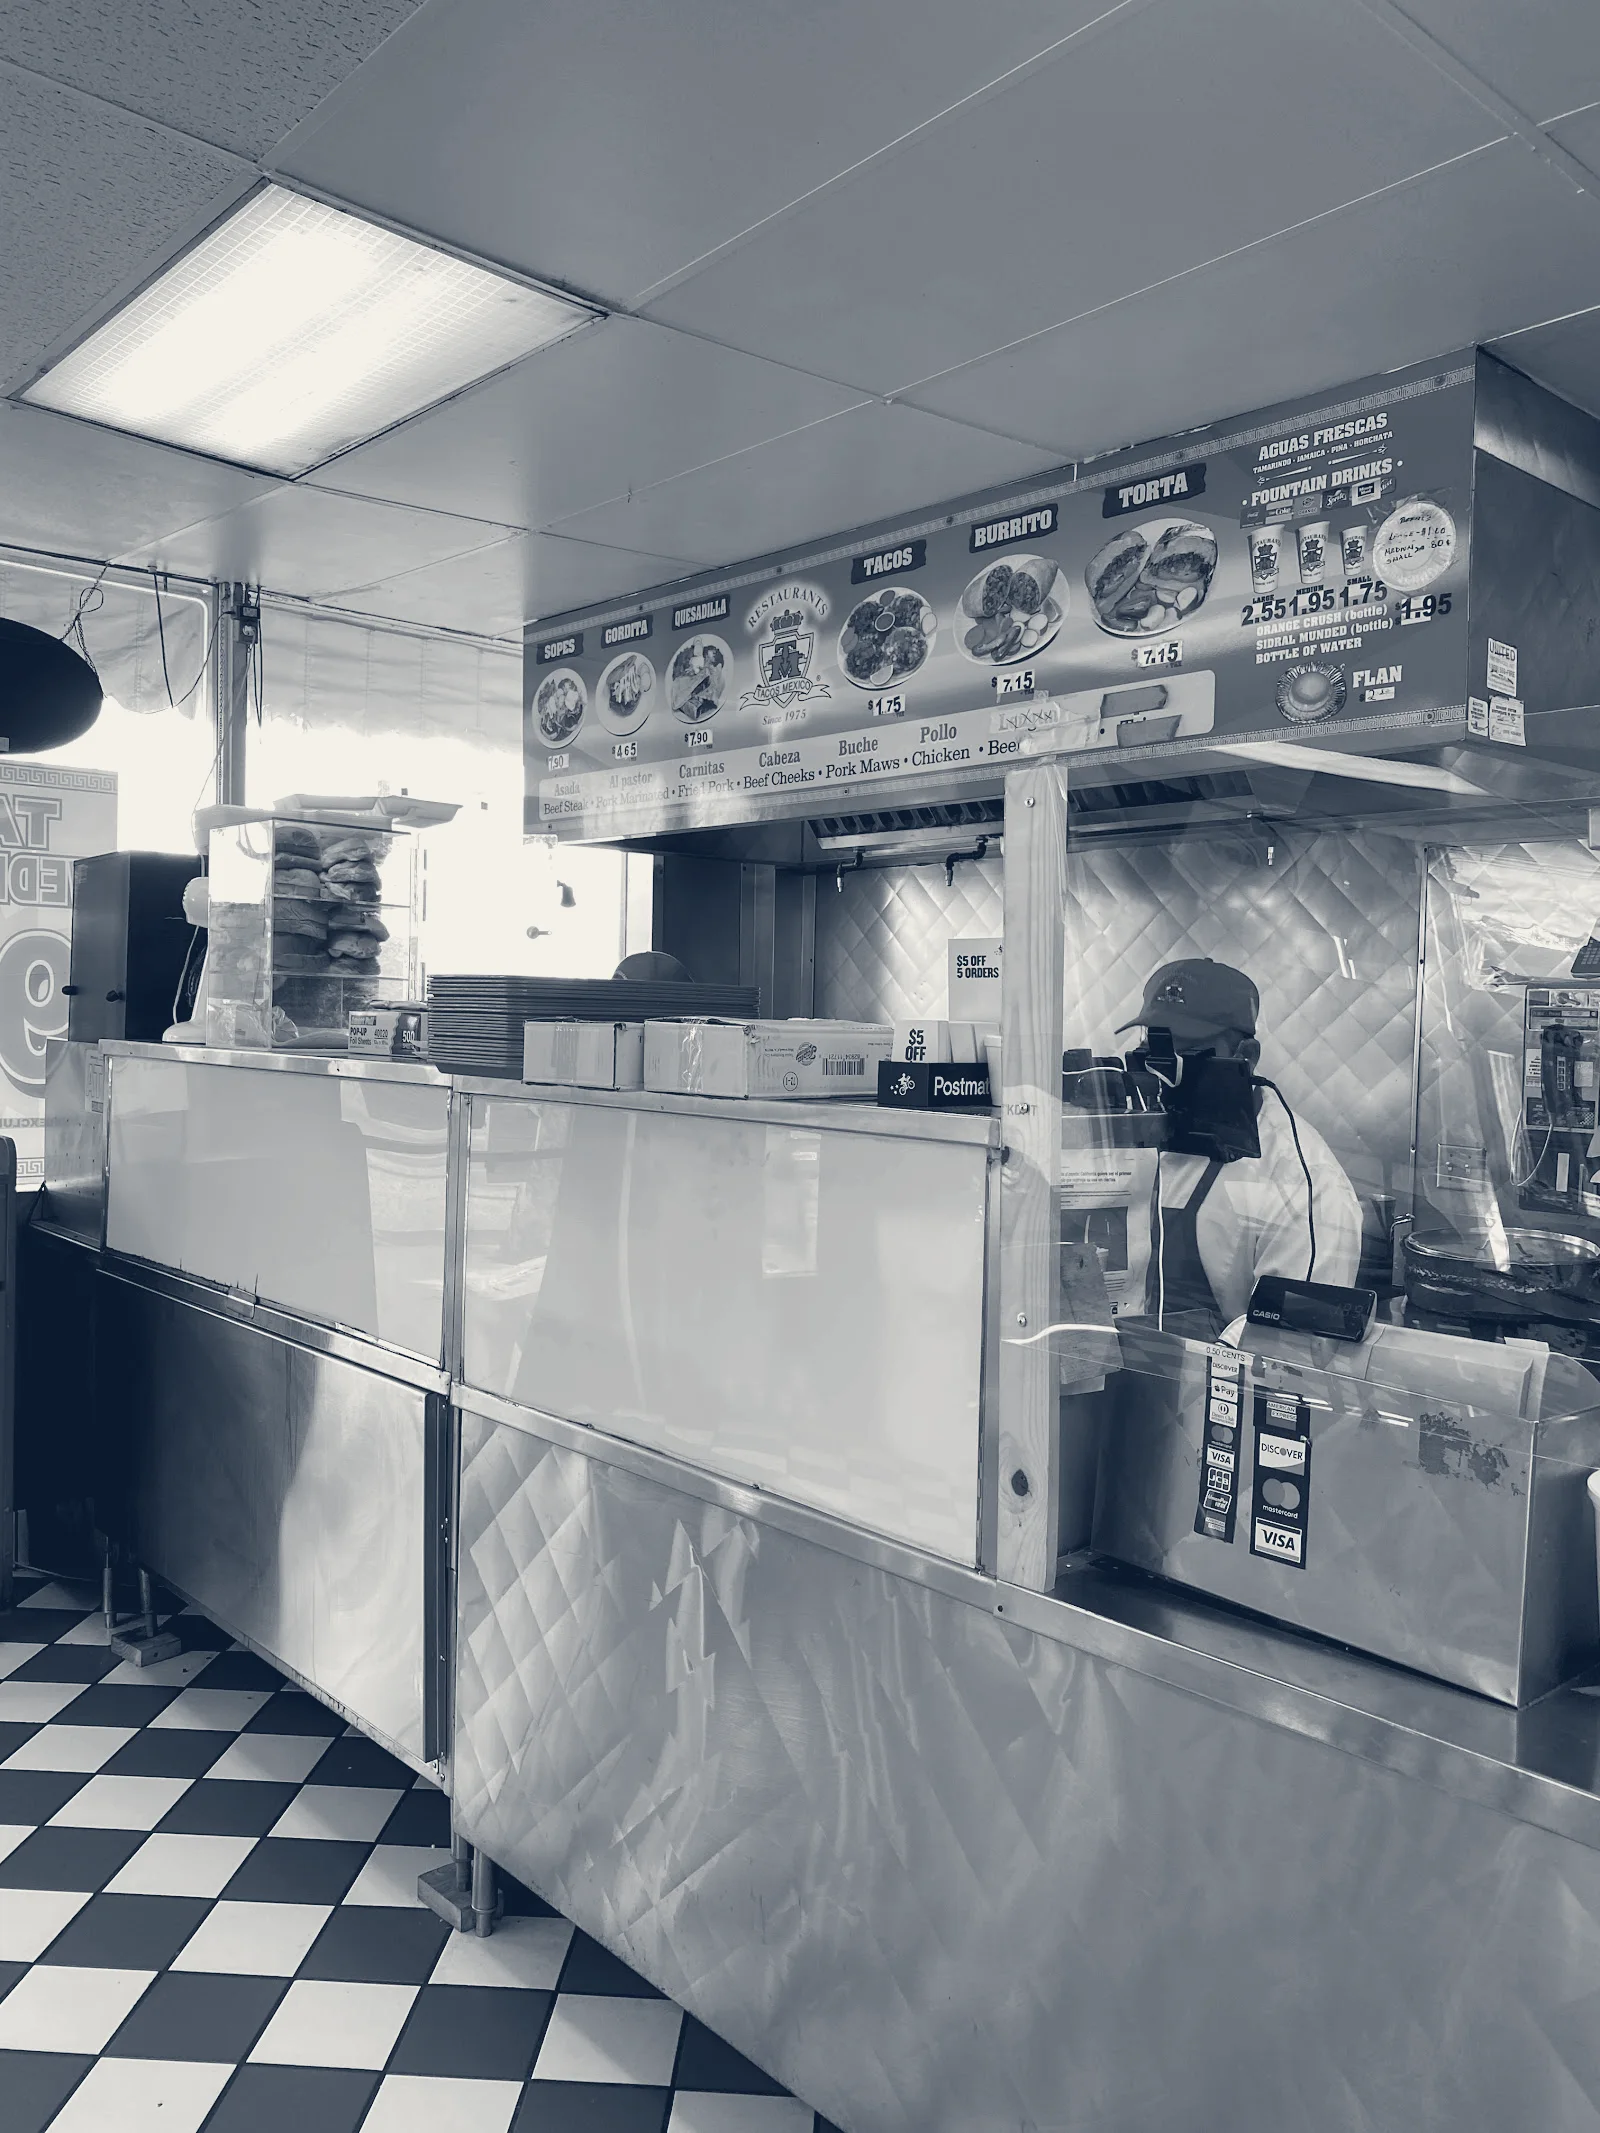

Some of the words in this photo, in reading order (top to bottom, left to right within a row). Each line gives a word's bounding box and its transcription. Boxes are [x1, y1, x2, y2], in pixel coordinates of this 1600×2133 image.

[1258, 434, 1310, 461] AGUAS
[1313, 412, 1388, 446] FRESCAS
[1252, 457, 1292, 474] TAMARINDO
[1297, 450, 1326, 463] JAMAICA
[1353, 431, 1393, 448] HORCHATA
[1118, 472, 1188, 509] TORTA
[1251, 474, 1328, 507] FOUNTAIN
[1331, 458, 1393, 487] DRINKS
[974, 508, 1053, 548] BURRITO
[863, 546, 913, 577] TACOS
[1295, 584, 1325, 596] MEDIUM
[1346, 576, 1372, 586] SMALL
[1288, 588, 1335, 616] 1.95
[1339, 580, 1388, 608] 1.75
[674, 598, 727, 628] QUESADILLA
[747, 586, 829, 628] RESTAURANTS
[1241, 597, 1287, 626] 2.55
[1256, 622, 1301, 638] ORANGE
[1302, 611, 1343, 628] CRUSH
[1344, 603, 1388, 623] (bottle)
[604, 619, 648, 645] GORDITA
[1256, 636, 1296, 651] SIDRAL
[1298, 627, 1348, 644] MUNDED
[1350, 617, 1394, 636] (bottle)
[544, 638, 576, 660] SOPES
[1130, 642, 1179, 665] $7.15
[1255, 649, 1300, 665] BOTTLE
[1302, 645, 1318, 657] OF
[1320, 637, 1363, 654] WATER
[991, 671, 1033, 693] $7.15
[1352, 664, 1403, 688] FLAN
[756, 686, 781, 699] TACOS
[781, 680, 811, 694] MEXICO
[867, 696, 901, 715] $1.75
[784, 709, 807, 723] 1975
[684, 731, 708, 746] $7.90
[919, 723, 958, 744] Pollo
[838, 736, 879, 757] Buche
[758, 750, 801, 768] Cabeza
[543, 802, 564, 816] Beef
[563, 798, 589, 813] Steak
[595, 795, 619, 809] Pork
[677, 783, 706, 798] Fried
[707, 779, 735, 794] Pork
[743, 774, 770, 789] Beef
[770, 770, 816, 786] Cheeks
[825, 762, 857, 779] Pork
[859, 757, 901, 775] Maws
[911, 745, 970, 767] Chicken
[987, 739, 1022, 756] Bee
[608, 774, 620, 788] Al
[620, 771, 653, 788] pastor
[678, 761, 725, 779] Carnitas
[554, 782, 581, 797] Asada
[956, 954, 969, 968] $5
[970, 955, 987, 967] OFF
[956, 967, 963, 979] 5
[965, 967, 1000, 979] ORDERS
[350, 1026, 368, 1037] POP-UP
[402, 1030, 415, 1043] 500
[908, 1028, 925, 1046] $5
[905, 1046, 927, 1062] OFF
[1252, 1309, 1280, 1321] CASIO
[1206, 1346, 1221, 1356] 0.50
[1221, 1349, 1246, 1362] CENTS
[1212, 1361, 1238, 1374] DISCOVER
[1221, 1385, 1235, 1398] Pay
[1210, 1450, 1232, 1466] VISA
[1261, 1443, 1303, 1461] DISCOVER
[1262, 1504, 1299, 1519] mastercard
[1261, 1528, 1296, 1551] VISA
